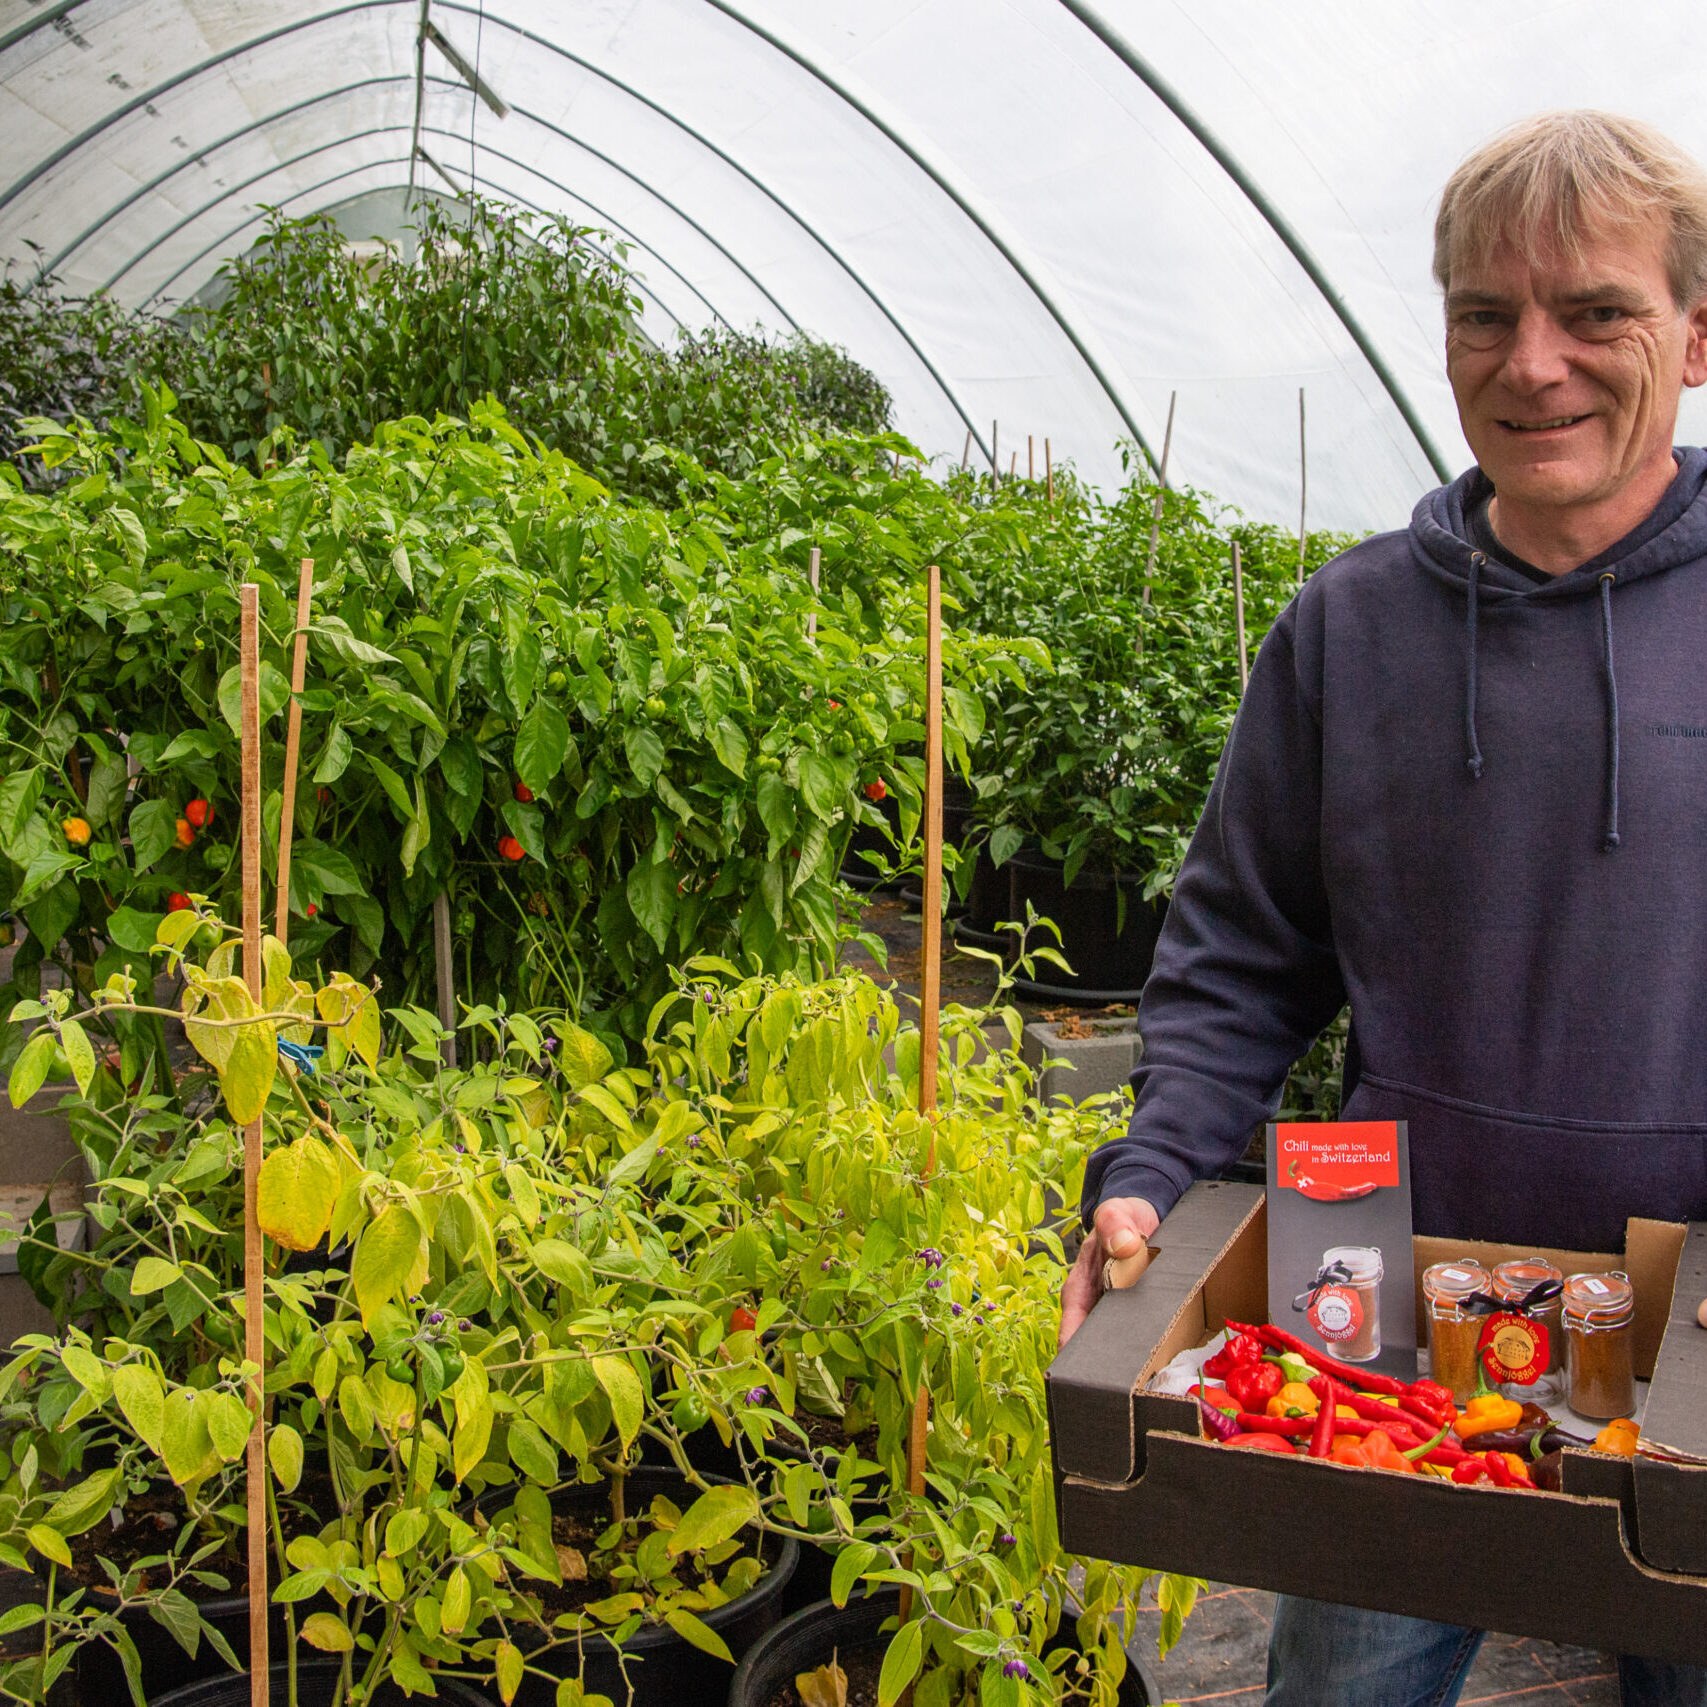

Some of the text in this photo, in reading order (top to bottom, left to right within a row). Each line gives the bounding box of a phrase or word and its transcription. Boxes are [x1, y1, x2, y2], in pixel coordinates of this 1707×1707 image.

[1284, 1139, 1309, 1152] Chili
[1311, 1144, 1331, 1152] made
[1351, 1143, 1368, 1151] love
[1321, 1150, 1391, 1163] Switzerland
[1328, 1289, 1341, 1297] with
[1342, 1292, 1354, 1306] love
[1491, 1318, 1541, 1345] made with love
[1488, 1356, 1537, 1381] Sennjöggel
